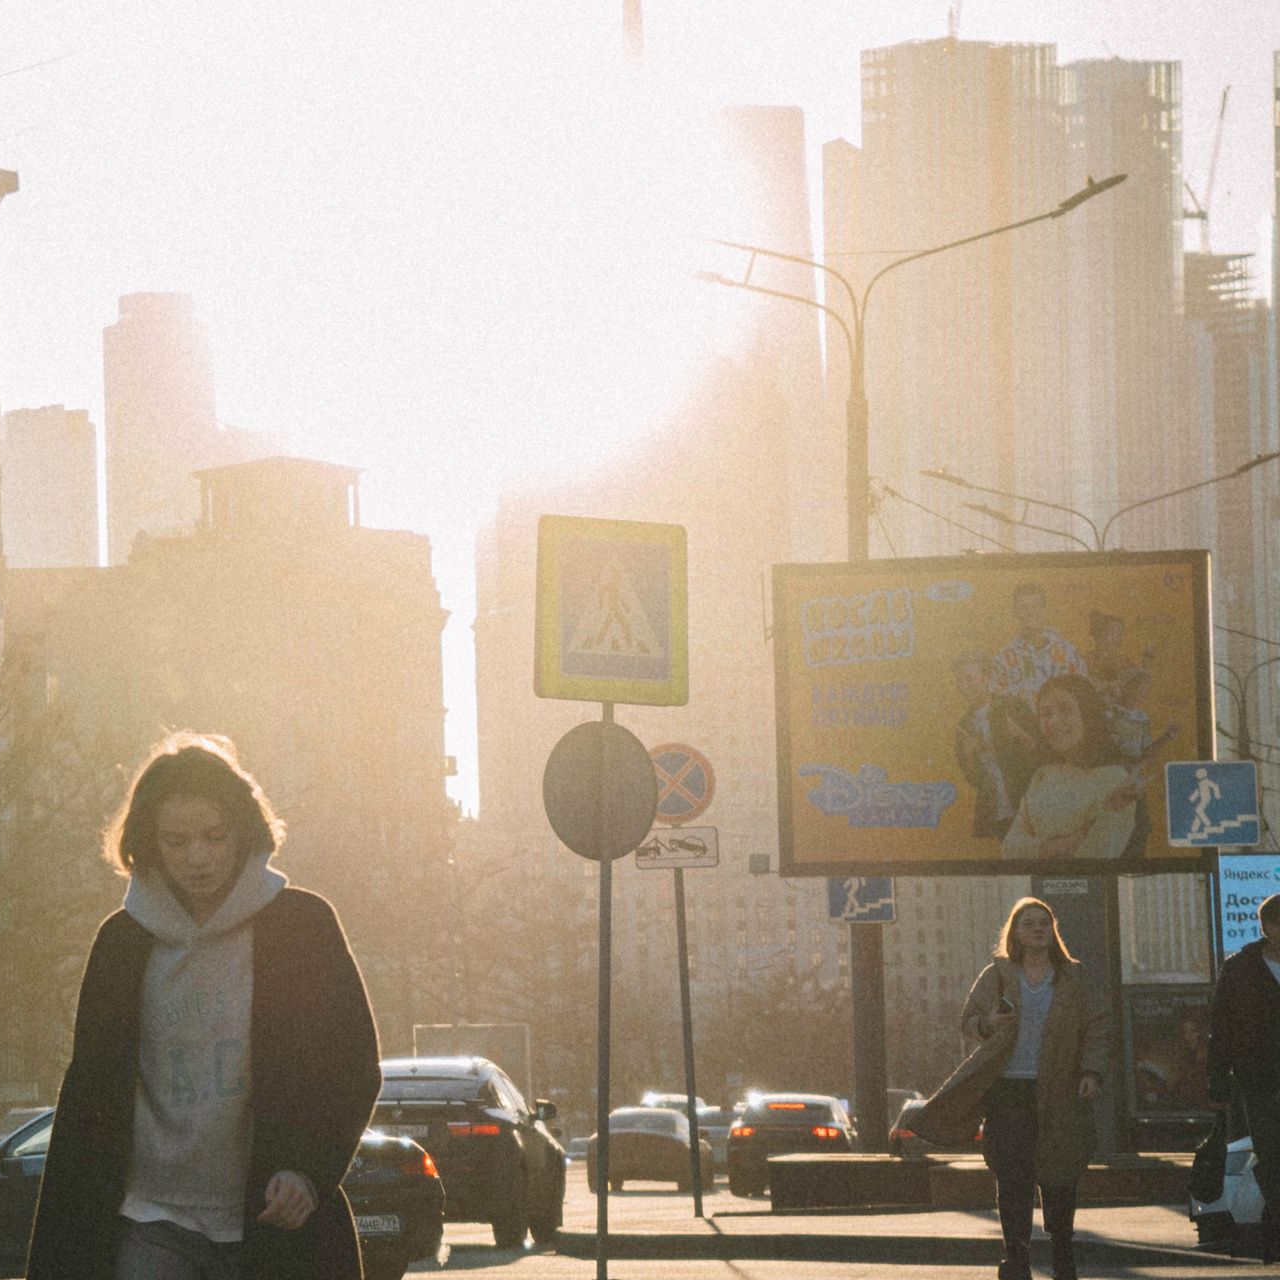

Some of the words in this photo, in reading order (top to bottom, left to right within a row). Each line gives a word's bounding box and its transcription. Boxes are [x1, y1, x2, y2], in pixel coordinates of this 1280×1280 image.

[804, 590, 912, 631] ПОСЛЕ
[807, 627, 912, 665] ШКОЛЫ
[811, 682, 908, 704] КАЖДУЮ
[812, 706, 908, 729] ПЯТНИЦУ
[852, 808, 928, 824] КАНАЛ
[1223, 868, 1270, 881] Яндекс
[1227, 927, 1246, 938] от
